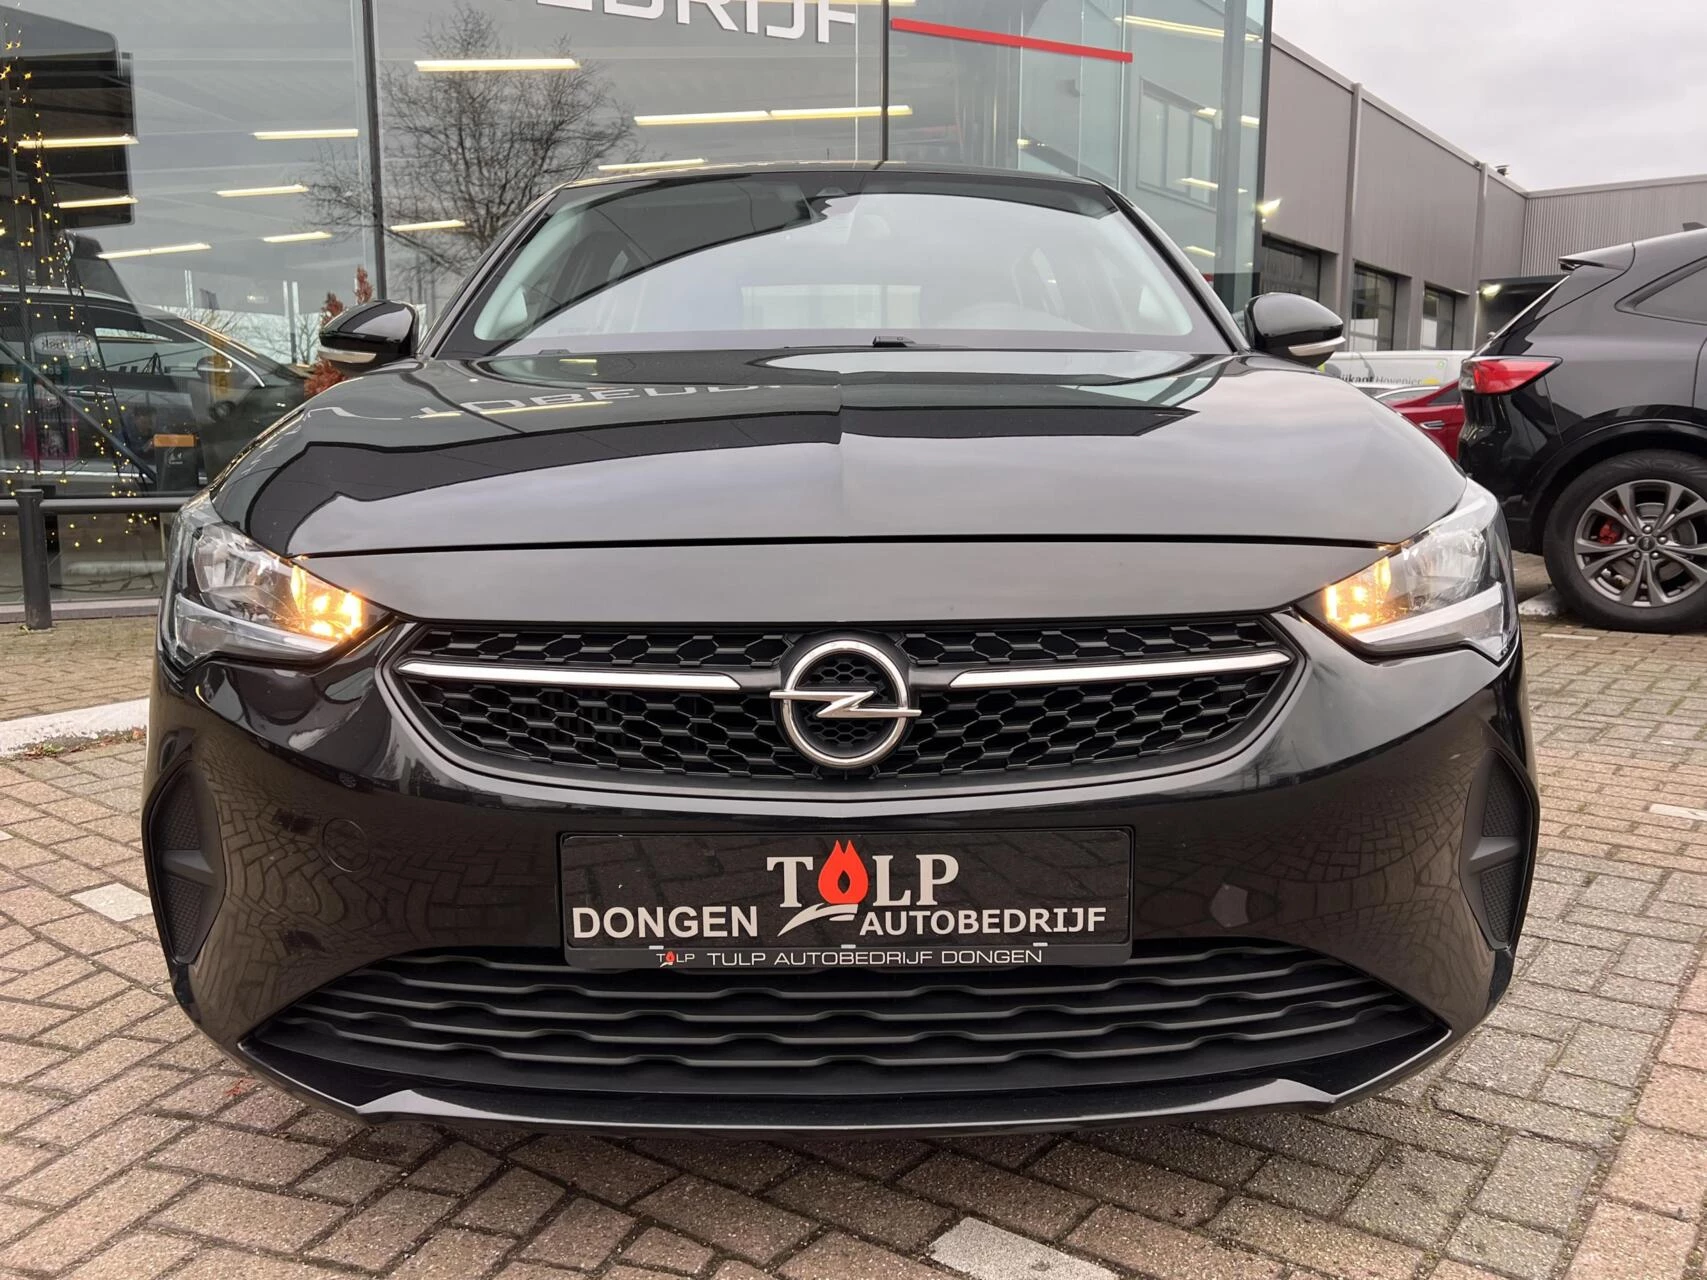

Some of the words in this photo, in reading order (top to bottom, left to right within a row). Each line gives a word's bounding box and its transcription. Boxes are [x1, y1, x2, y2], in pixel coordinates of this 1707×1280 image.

[572, 905, 758, 938] DONGEN
[859, 906, 1107, 936] AUTOBEDRIJF
[707, 952, 766, 966] TULP
[774, 950, 933, 966] AUTOBEDRIJF
[941, 949, 1042, 964] DONGEN
